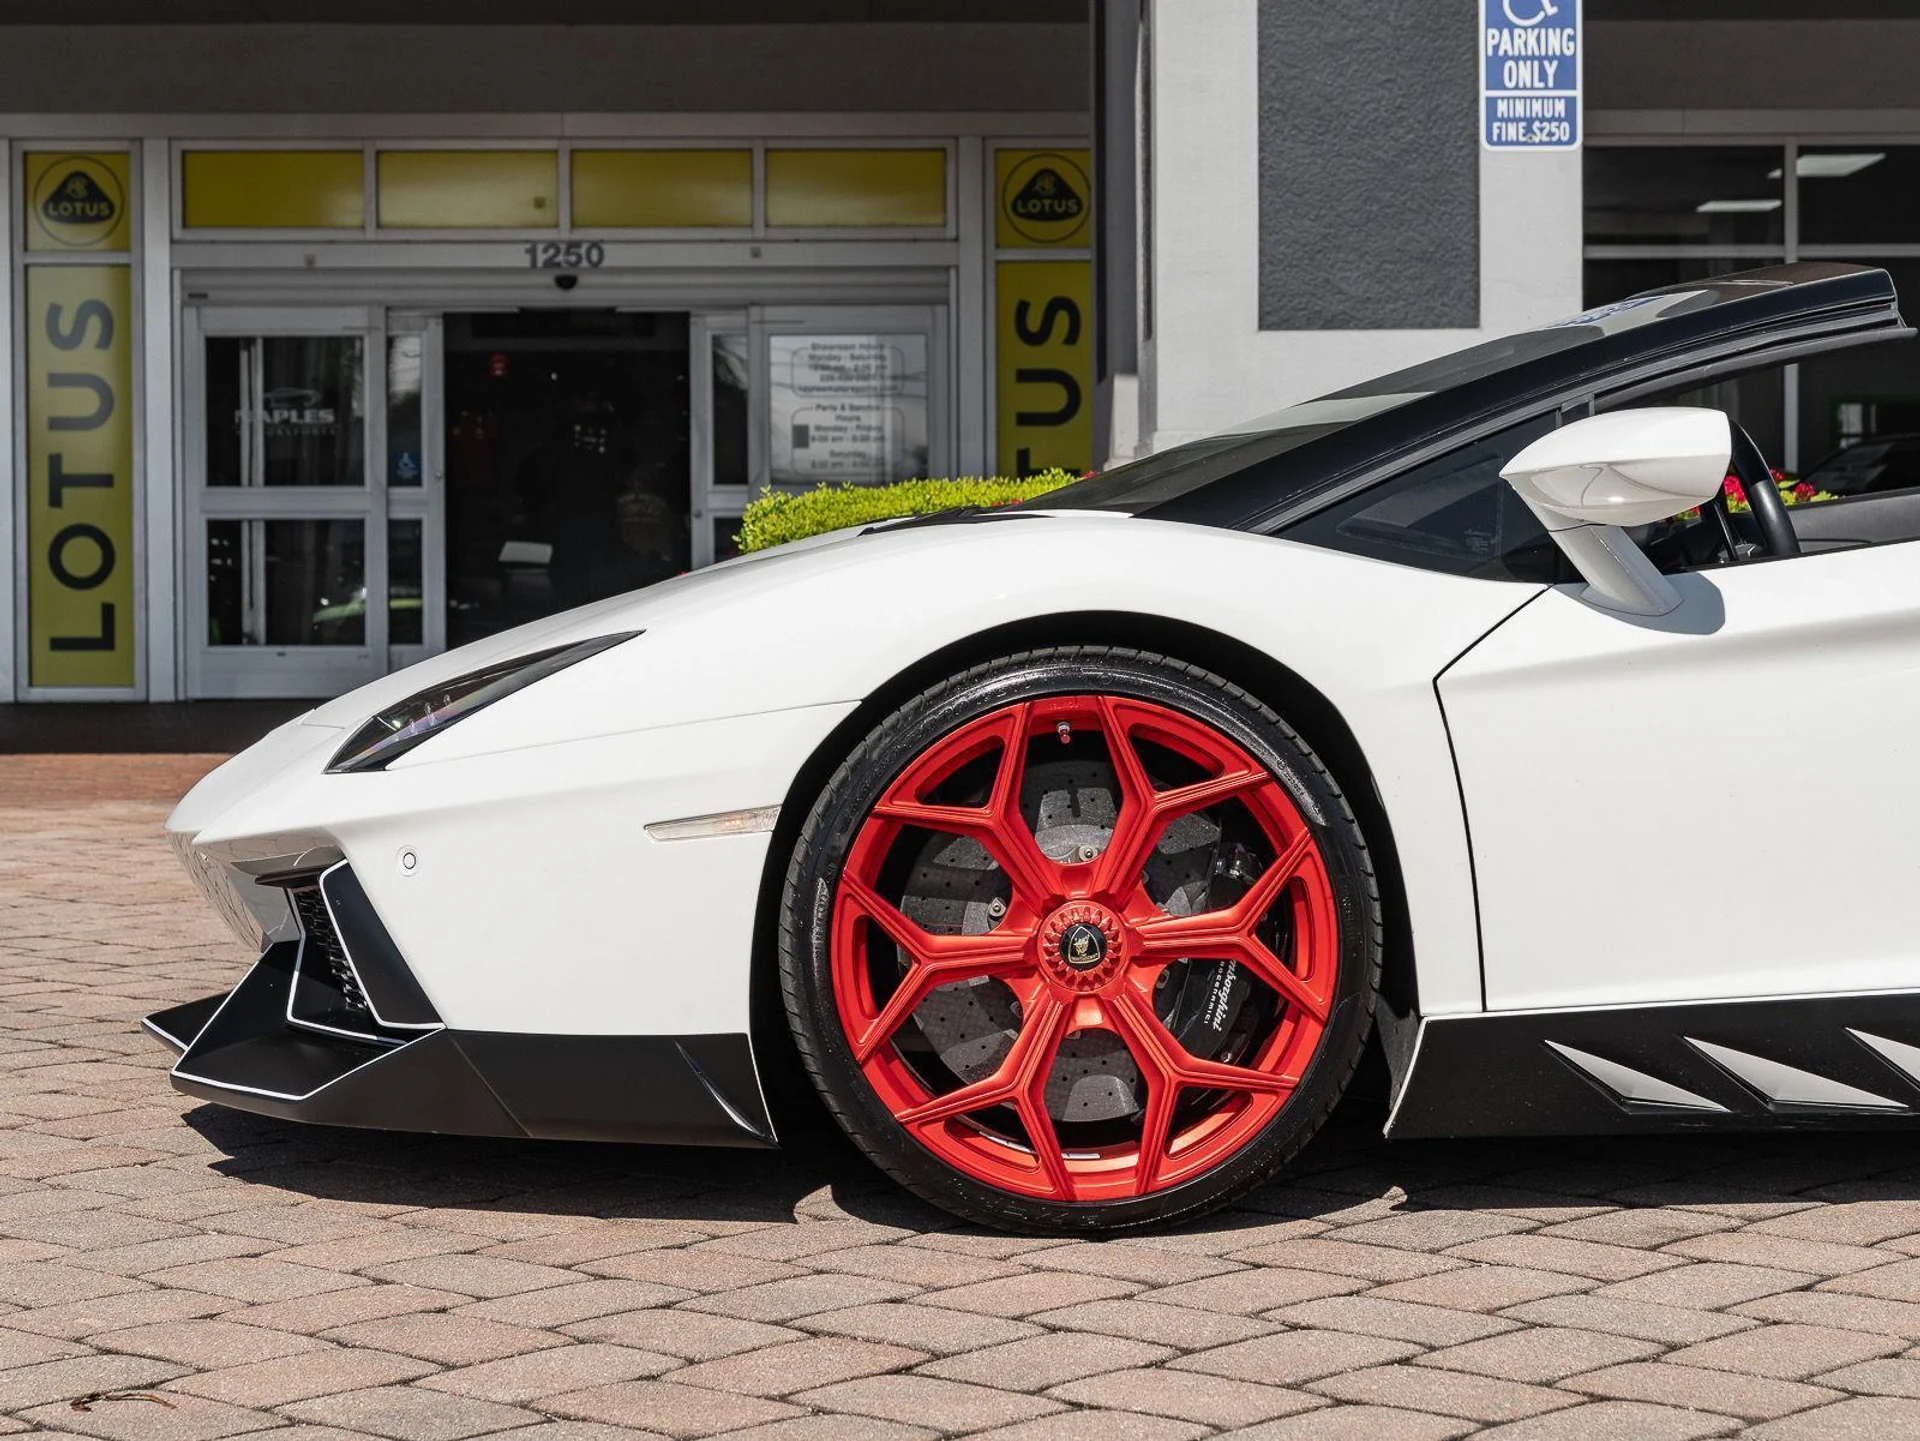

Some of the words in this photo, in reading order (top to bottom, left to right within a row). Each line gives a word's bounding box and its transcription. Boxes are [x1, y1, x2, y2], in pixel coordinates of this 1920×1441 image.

[1487, 28, 1575, 57] PARKING
[1503, 60, 1559, 88] ONLY
[1496, 98, 1566, 118] MINIMUM
[1492, 121, 1527, 142] FINE
[1532, 120, 1571, 143] $250
[47, 199, 112, 218] LOTUS
[1016, 198, 1080, 214] LOTUS
[524, 241, 605, 269] 1250
[46, 297, 117, 653] LOTUS
